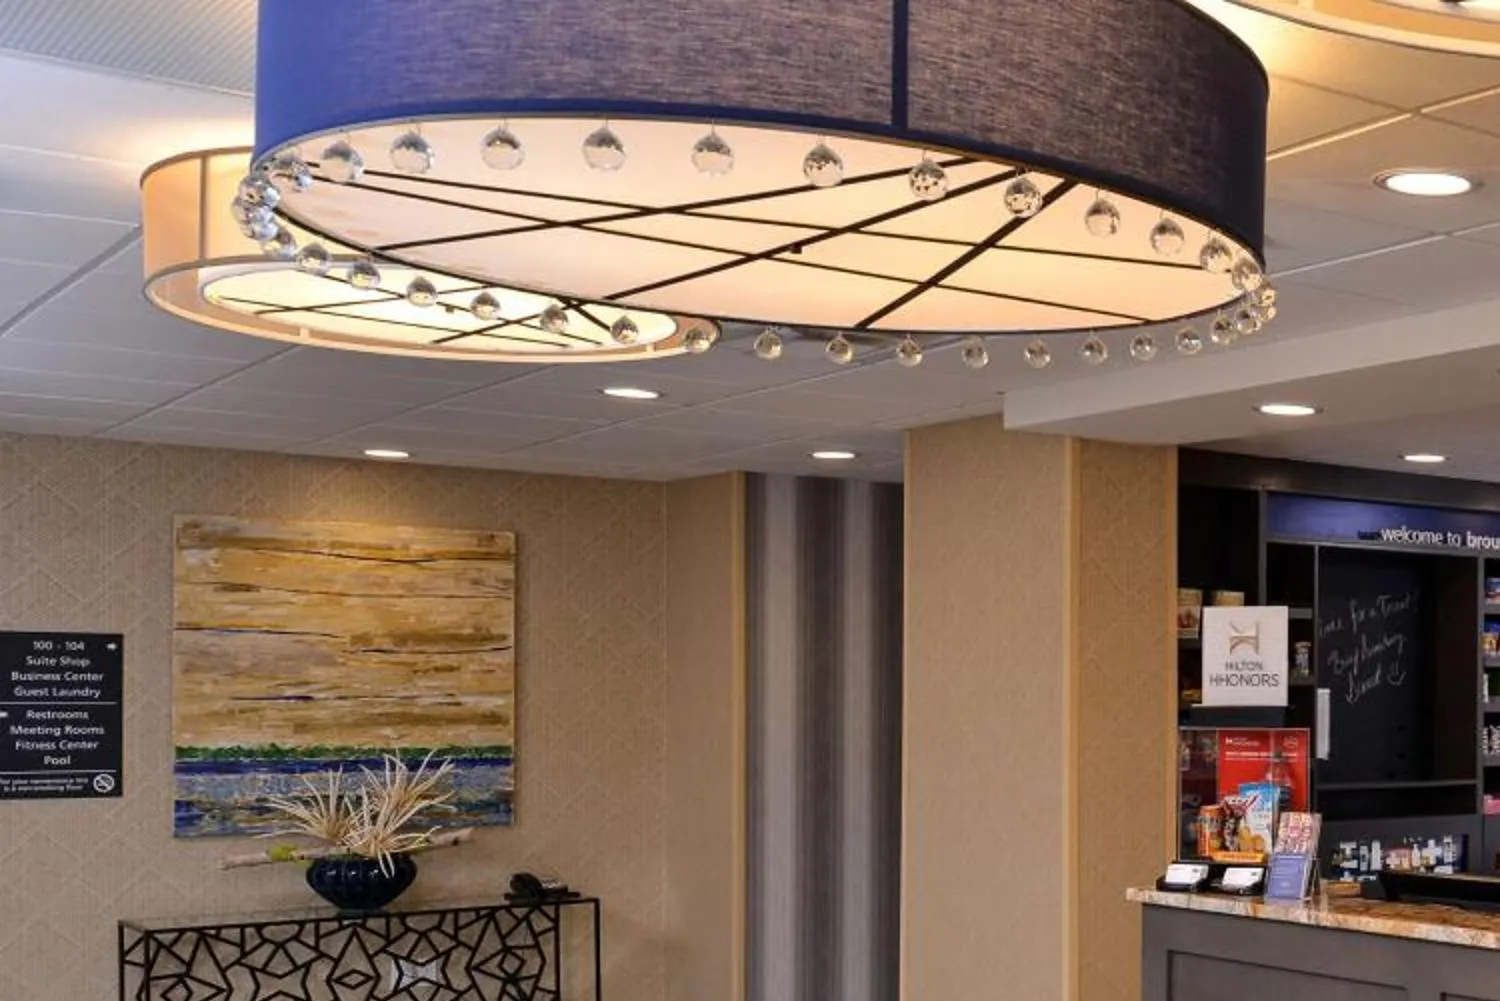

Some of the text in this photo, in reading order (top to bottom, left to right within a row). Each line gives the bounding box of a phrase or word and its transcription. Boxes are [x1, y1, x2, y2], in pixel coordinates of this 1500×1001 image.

[1381, 525, 1443, 545] welcome
[1447, 531, 1461, 547] to
[26, 656, 91, 668] Suite Shop
[1225, 660, 1264, 671] HILTON
[11, 671, 104, 681] Business Center
[1209, 673, 1280, 688] HHONORS
[14, 686, 101, 699] Guest Laundry
[26, 709, 90, 719] Restrooms
[9, 725, 105, 736] Meeting Rooms
[15, 740, 99, 750] Fitness Center
[43, 755, 71, 765] Pool
